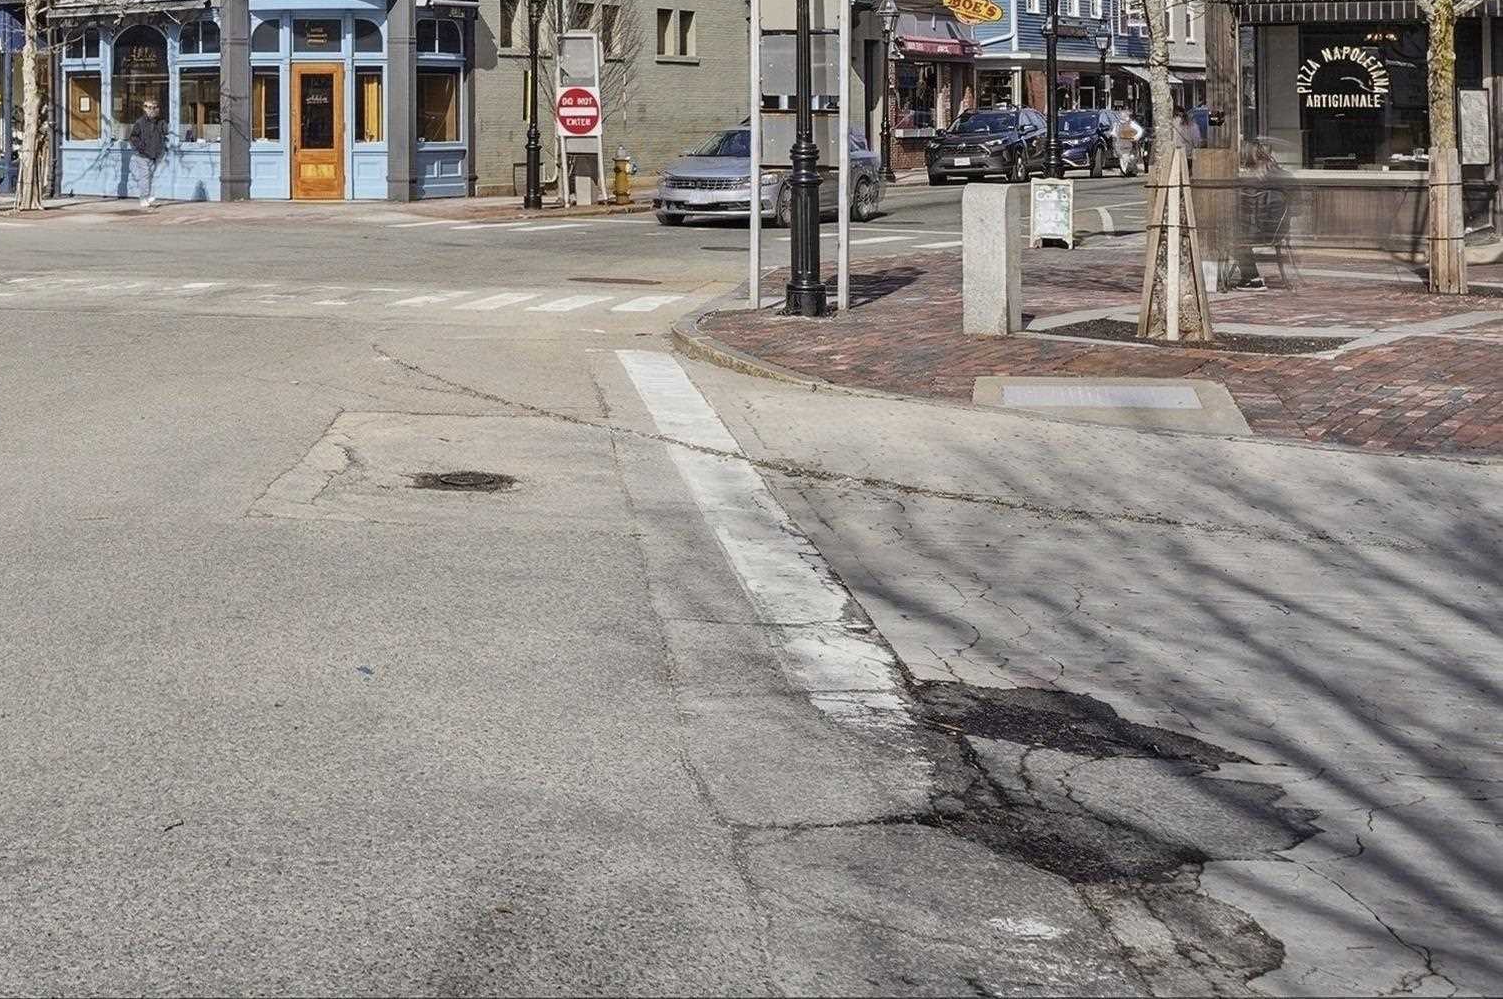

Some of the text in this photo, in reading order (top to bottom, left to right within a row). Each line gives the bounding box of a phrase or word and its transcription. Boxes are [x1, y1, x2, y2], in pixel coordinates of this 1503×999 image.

[1297, 46, 1389, 94] PIZZA NAPOLETANA
[561, 97, 594, 106] DO NOT
[1306, 94, 1382, 108] ARTIGIANALE
